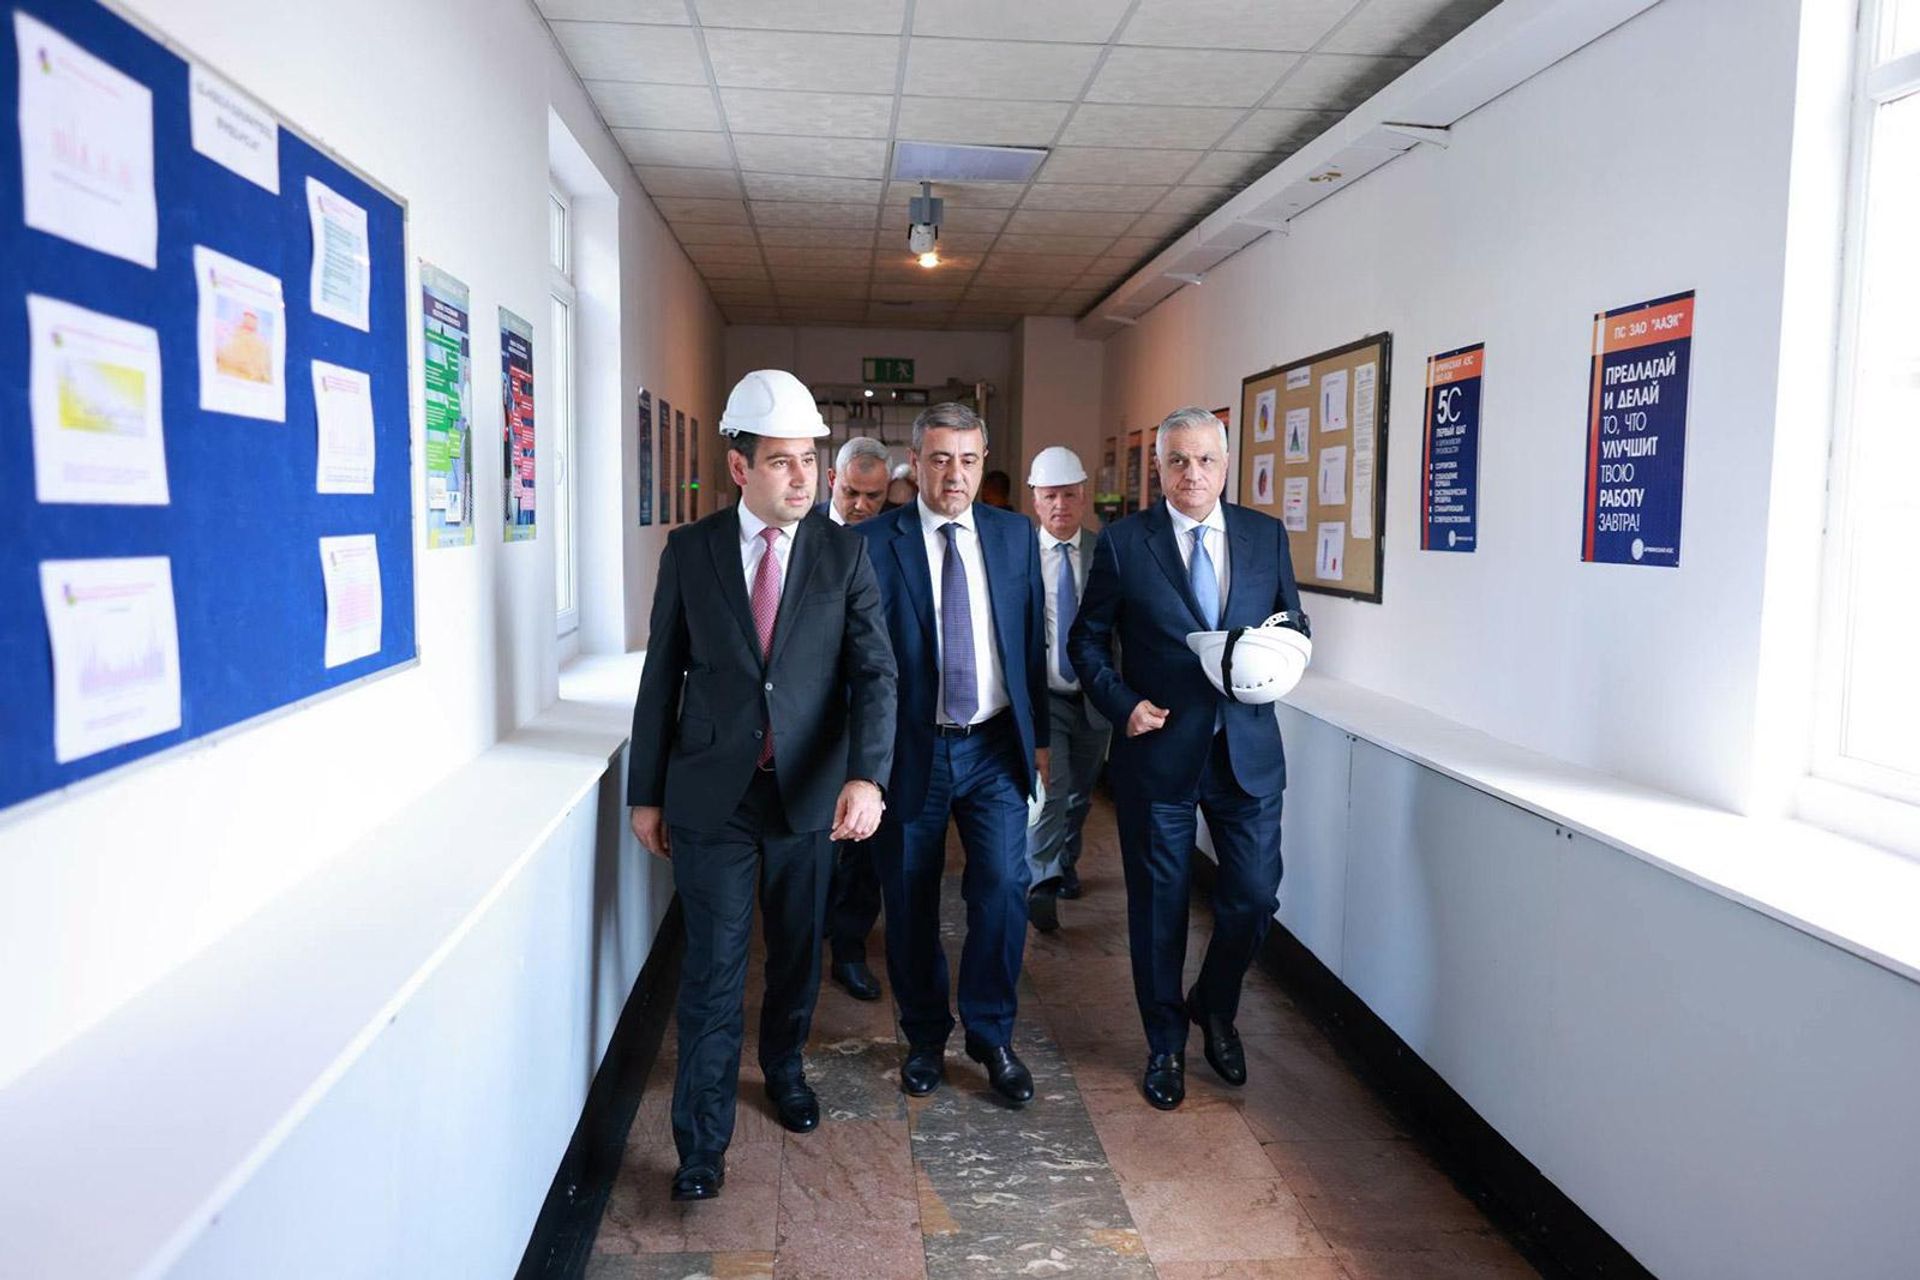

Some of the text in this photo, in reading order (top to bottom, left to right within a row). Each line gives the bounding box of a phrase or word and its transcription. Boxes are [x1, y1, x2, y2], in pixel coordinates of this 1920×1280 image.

[1629, 321, 1647, 336] ЗАО
[1605, 351, 1676, 386] ПРЕДЛАГАЙ
[1604, 380, 1660, 410] И ДЕЛАЙ
[1603, 411, 1647, 435] ТО, ЧТО
[1602, 436, 1658, 459] УЛУЧШИТ
[1600, 463, 1635, 483] ТВОЮ
[1600, 488, 1645, 508] РАБОТУ
[1598, 513, 1641, 532] ЗАВТРА!
